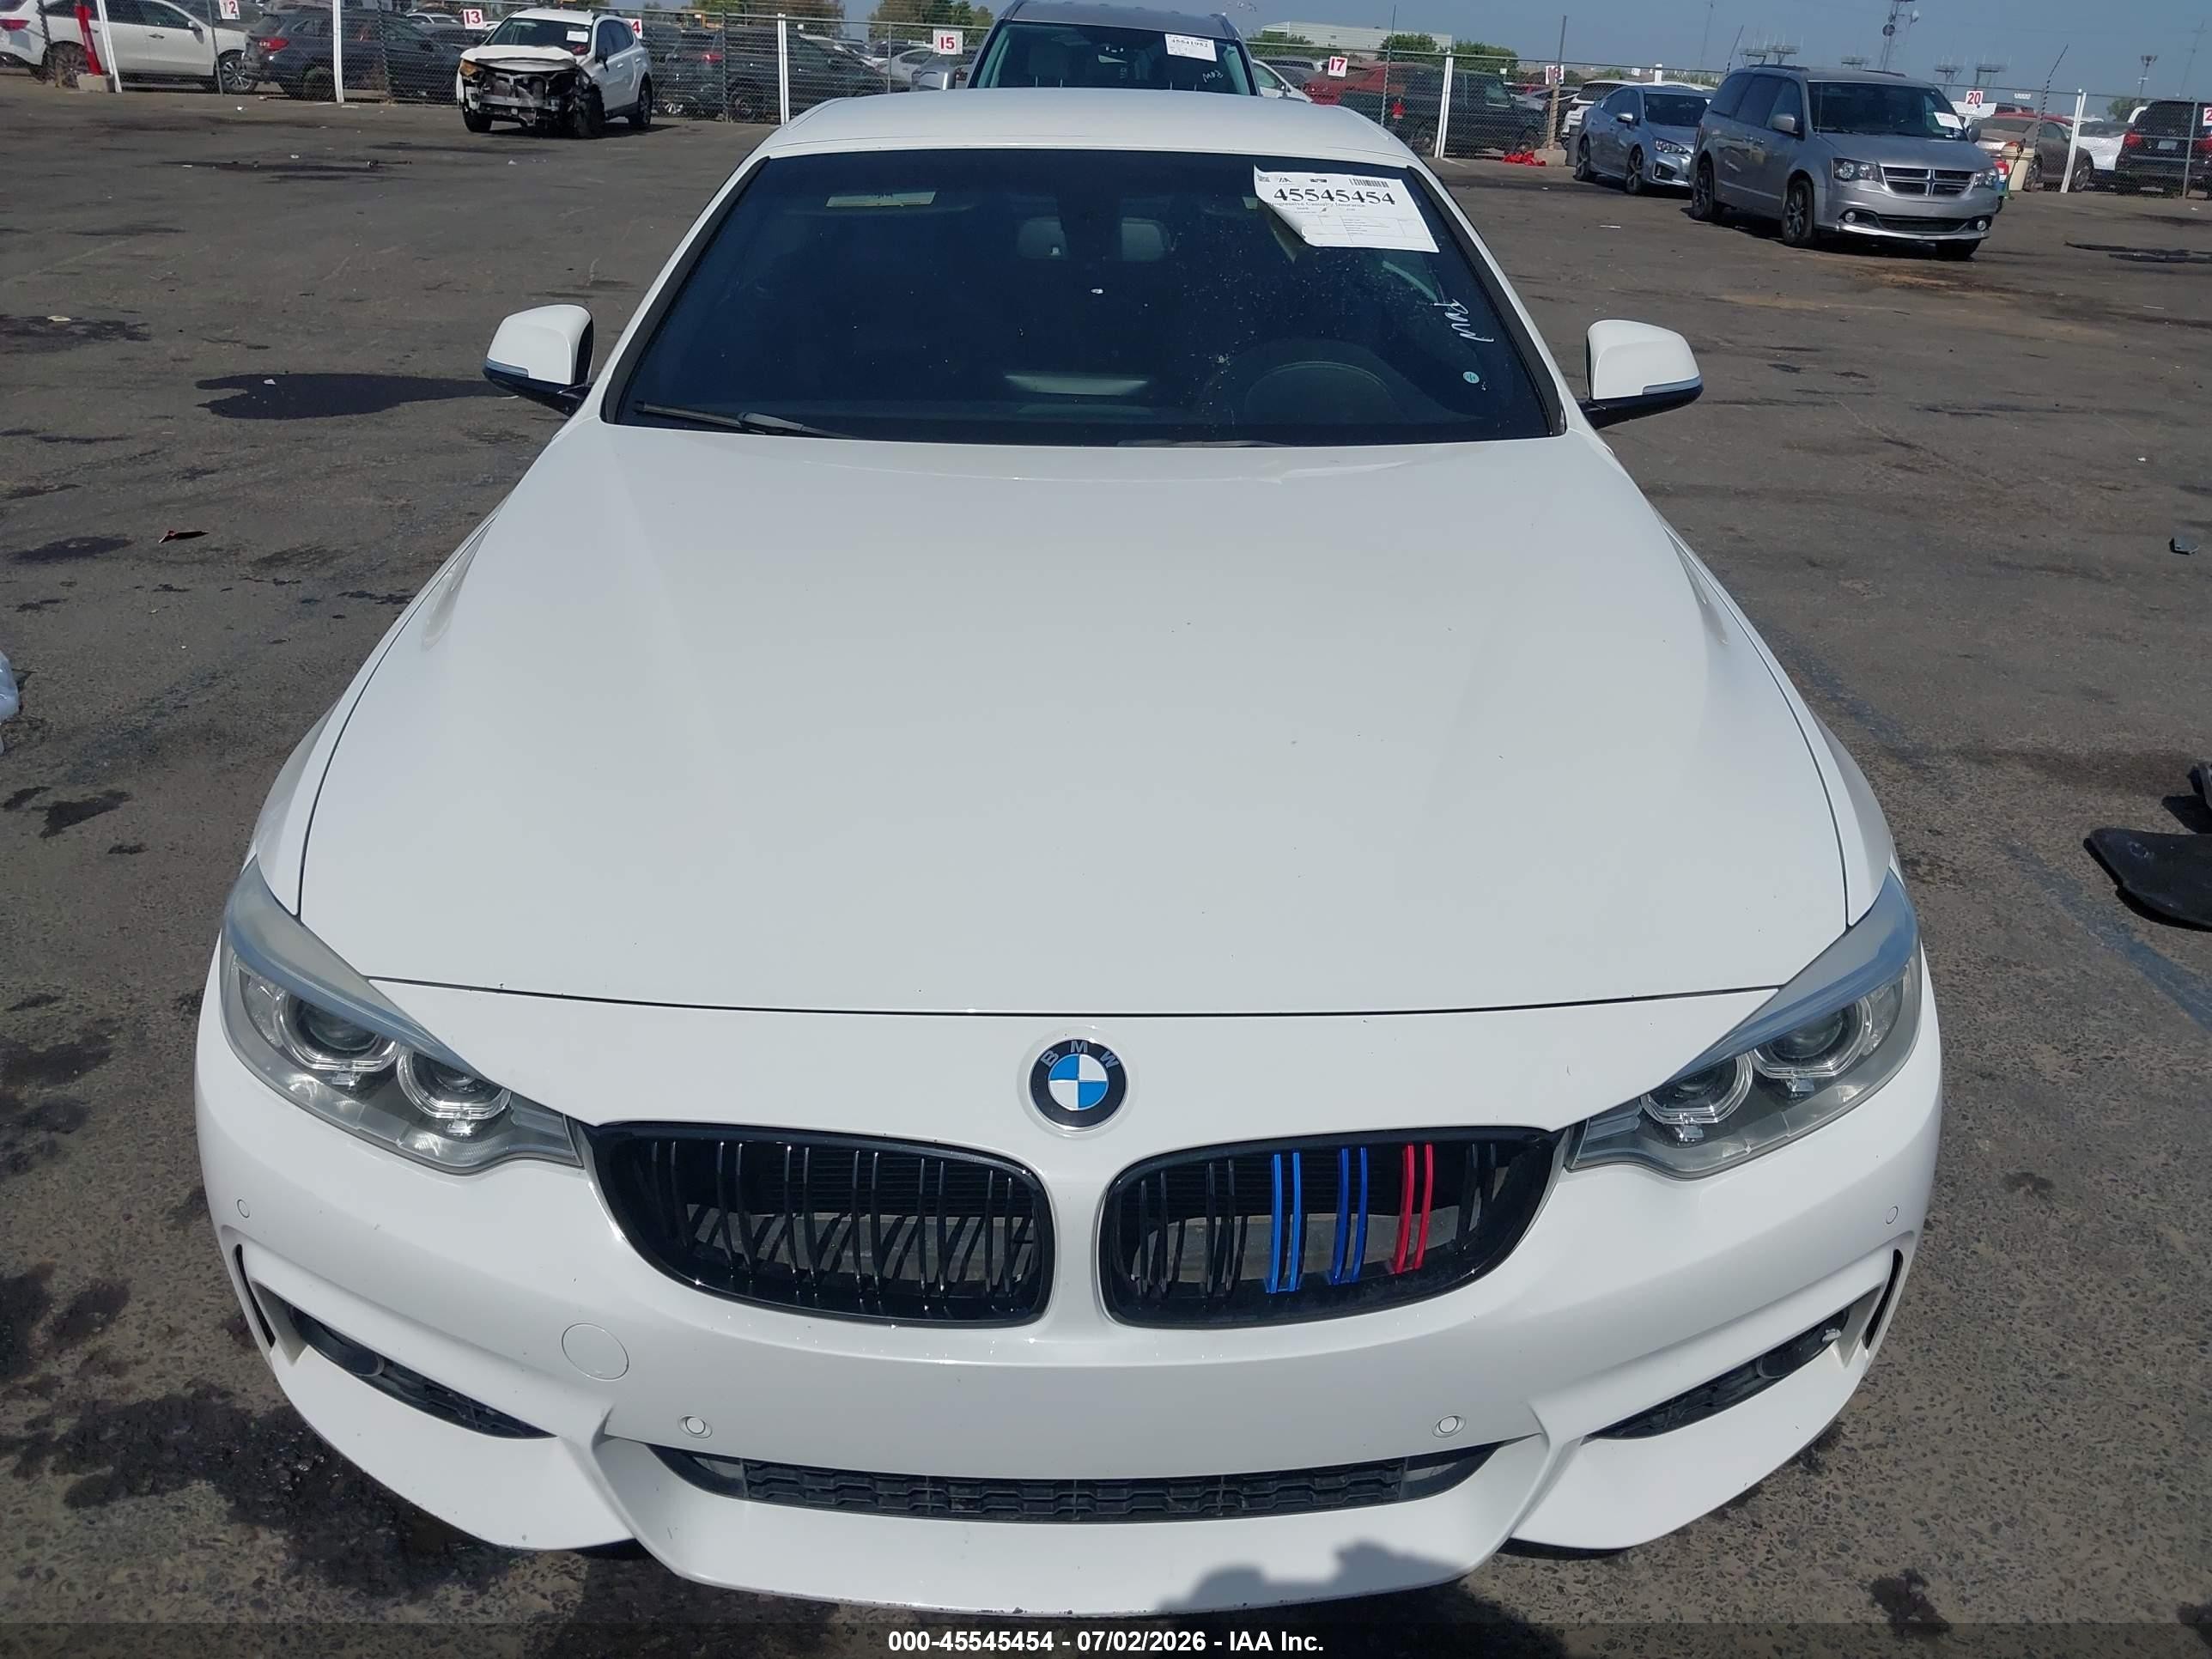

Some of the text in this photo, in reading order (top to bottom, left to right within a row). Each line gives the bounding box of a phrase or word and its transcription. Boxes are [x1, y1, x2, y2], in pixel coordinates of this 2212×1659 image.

[223, 1, 237, 14] 12
[465, 10, 481, 24] 13
[632, 21, 641, 33] 4
[940, 36, 955, 50] 15
[1331, 58, 1346, 71] 17
[1967, 92, 1981, 105] 20
[2205, 109, 2212, 120] 2
[1273, 188, 1395, 205] 45545454
[1041, 1040, 1119, 1068] BMW
